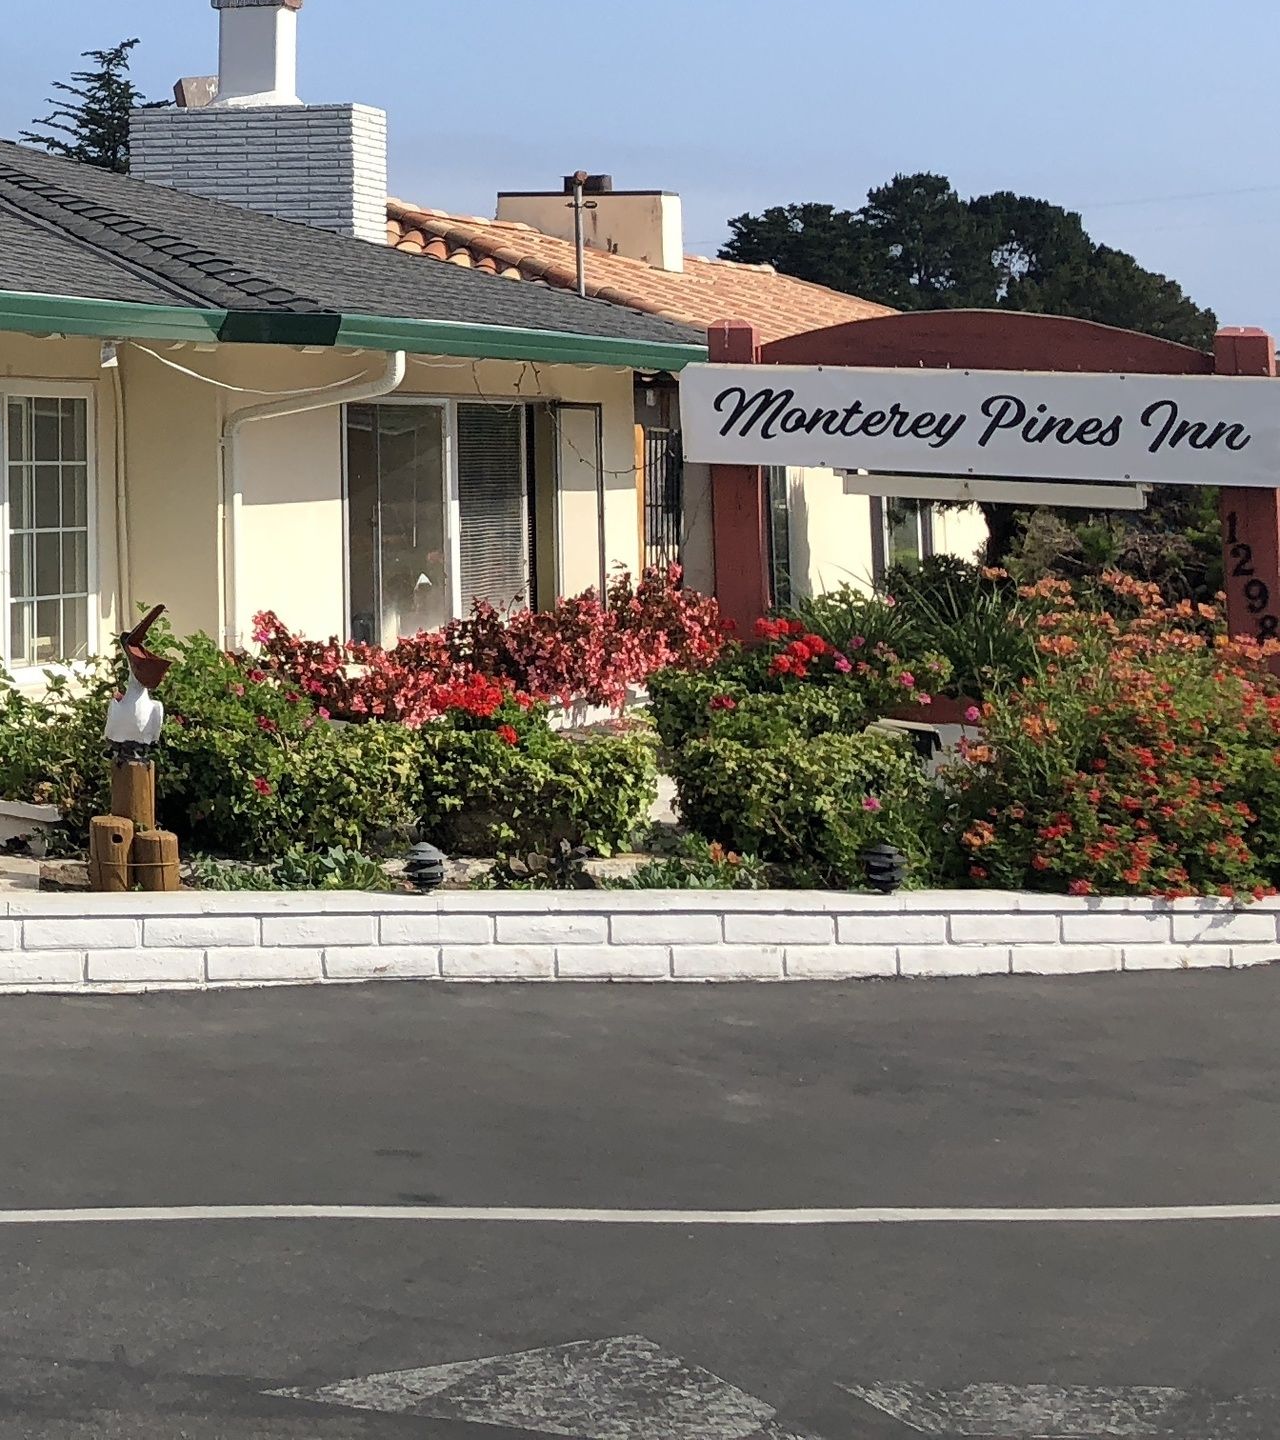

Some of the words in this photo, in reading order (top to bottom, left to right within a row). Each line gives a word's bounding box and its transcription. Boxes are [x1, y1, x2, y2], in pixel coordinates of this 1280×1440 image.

[713, 386, 967, 449] Monterey
[977, 394, 1123, 448] Pines
[1140, 399, 1252, 454] Inn
